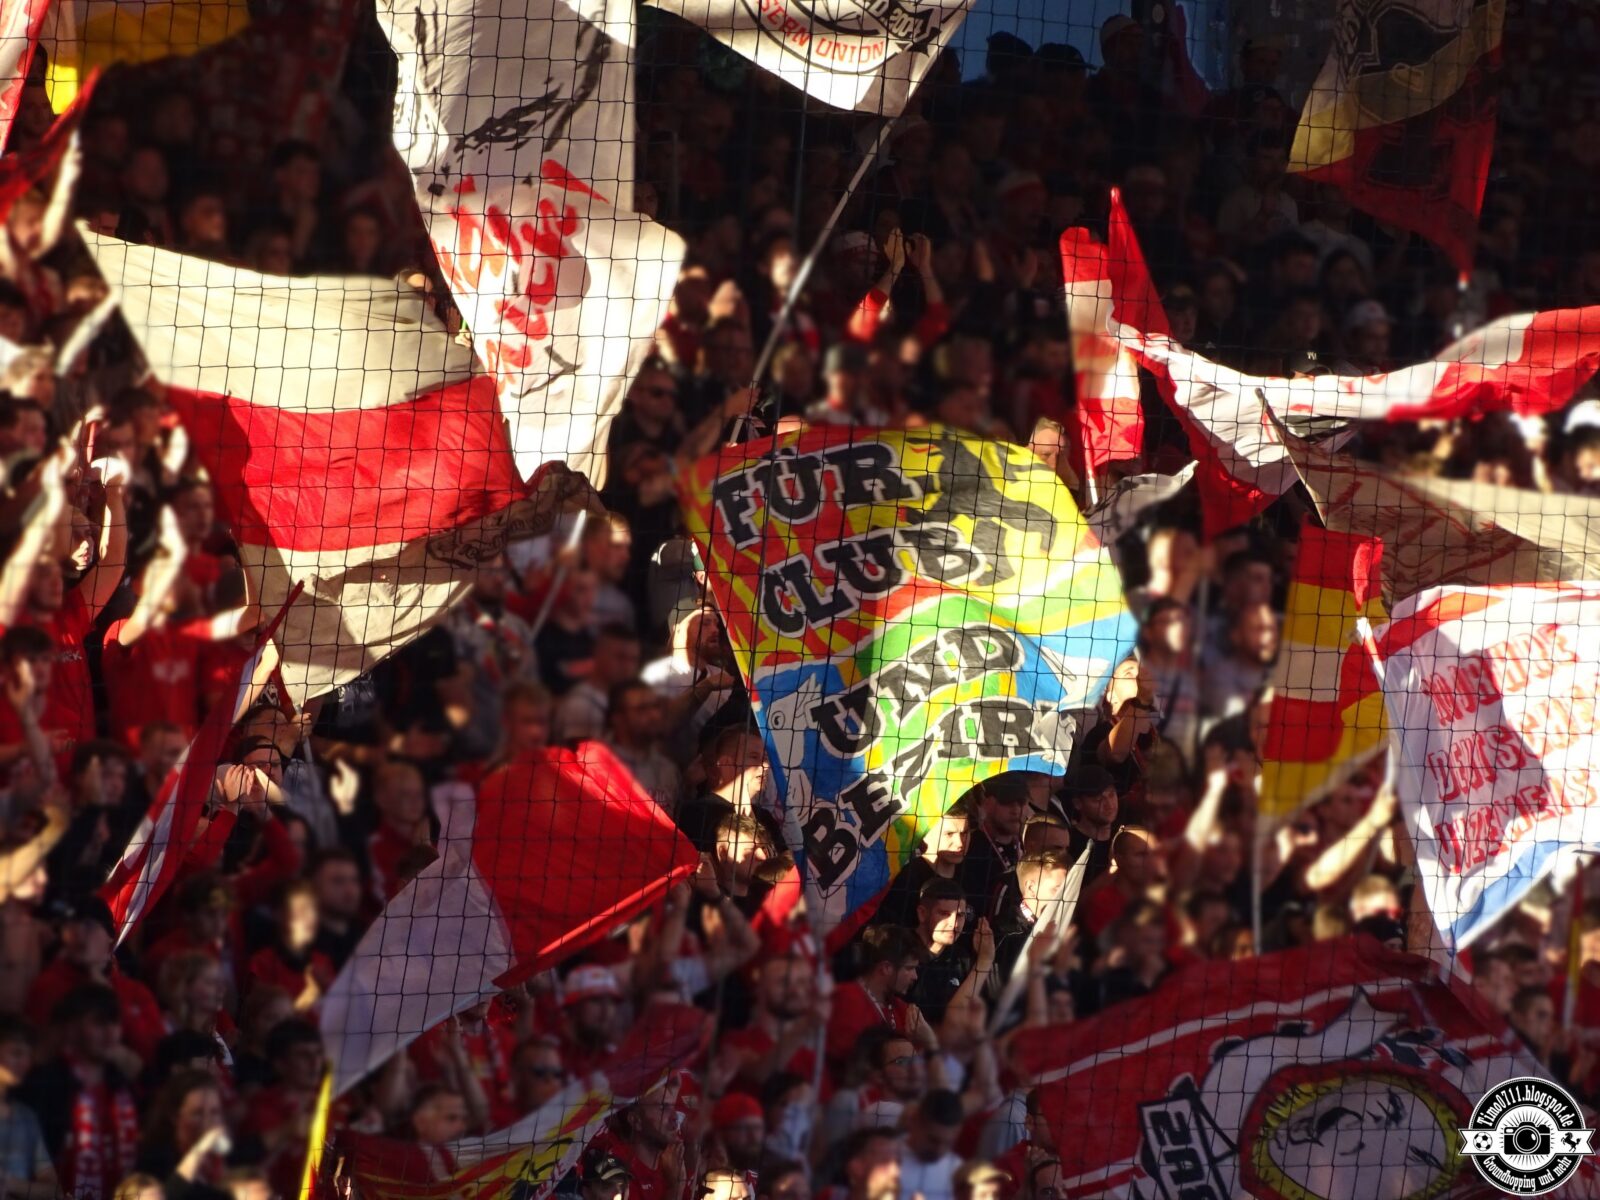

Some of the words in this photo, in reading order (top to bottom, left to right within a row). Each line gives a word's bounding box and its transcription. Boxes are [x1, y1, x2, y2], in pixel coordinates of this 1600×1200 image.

[815, 37, 885, 64] UNION
[761, 521, 987, 638] CLUB
[804, 620, 1023, 757] UND
[799, 697, 1056, 894] BEZIR
